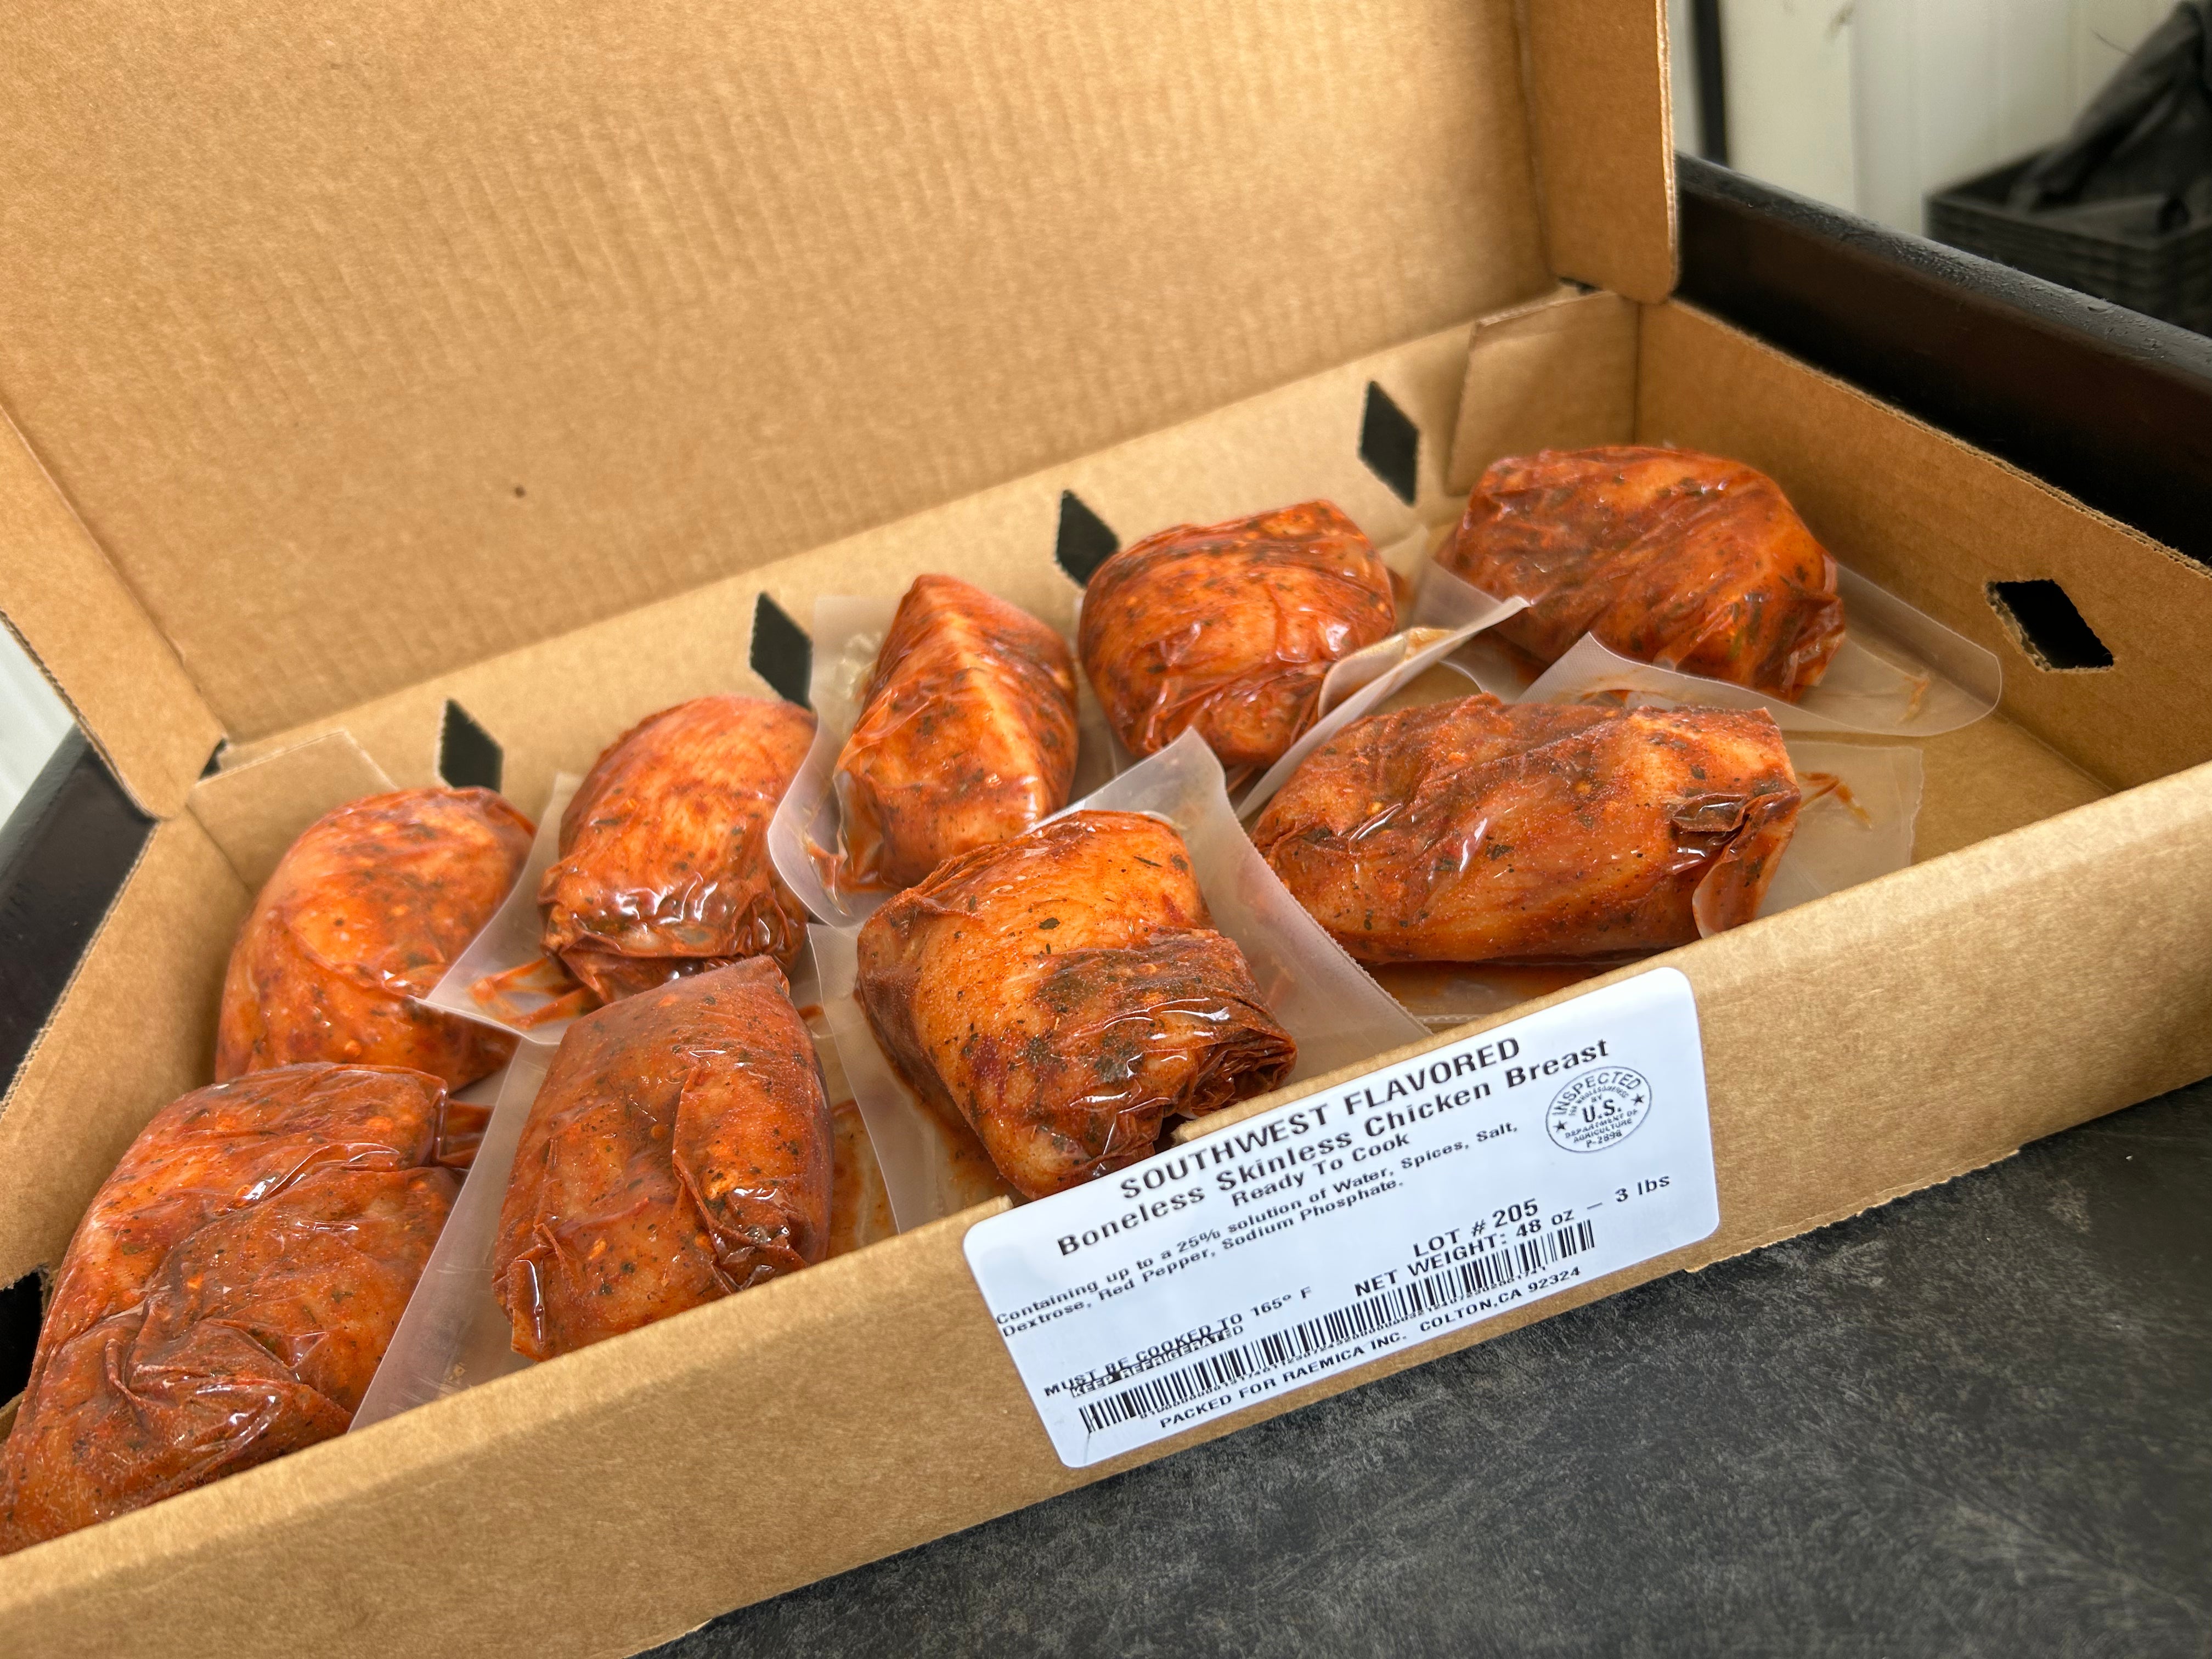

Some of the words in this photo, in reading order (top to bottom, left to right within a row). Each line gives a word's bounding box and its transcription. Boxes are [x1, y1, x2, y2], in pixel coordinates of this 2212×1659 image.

[1120, 1103, 1328, 1198] SOUTHWEST
[1344, 1037, 1520, 1115] FLAVORED
[1551, 1071, 1641, 1115] INSPECTED
[1565, 1113, 1624, 1138] DEPARTMENT
[1573, 1118, 1633, 1143] AGRICULTURE
[1582, 1098, 1622, 1123] U.S.
[1057, 1186, 1205, 1256] Boneless
[1215, 1131, 1352, 1190] Skinless
[1363, 1081, 1491, 1138] Chicken
[1505, 1039, 1609, 1088] Breast
[1231, 1171, 1305, 1207] Ready
[1313, 1156, 1344, 1177] To
[1352, 1133, 1410, 1163] Cook
[996, 1280, 1098, 1325] Containing
[1106, 1267, 1130, 1283] up
[1136, 1257, 1154, 1270] to
[1161, 1249, 1172, 1260] a
[1177, 1228, 1221, 1252] 25%
[1228, 1199, 1302, 1233] solution
[1308, 1189, 1327, 1203] of
[1332, 1167, 1394, 1193] Water,
[1401, 1141, 1469, 1170] Spices,
[1476, 1121, 1517, 1142] Salt,
[1002, 1300, 1092, 1338] Dextrose,
[1098, 1278, 1136, 1301] Red
[1142, 1248, 1216, 1283] Pepper,
[1222, 1216, 1294, 1250] Sodium
[1300, 1179, 1404, 1222] Phosphate.
[1354, 1269, 1398, 1297] NET
[1407, 1232, 1506, 1277] WEIGHT:
[1516, 1218, 1541, 1237] 48
[1551, 1209, 1574, 1225] oz
[1615, 1188, 1628, 1202] 3
[1637, 1176, 1671, 1195] lbs
[1413, 1228, 1460, 1257] LOT
[1471, 1219, 1486, 1237] #
[1492, 1197, 1538, 1228] 205
[1044, 1369, 1097, 1397] MUST
[1104, 1356, 1130, 1372] BE
[1136, 1324, 1211, 1363] COOKED
[1217, 1313, 1243, 1331] TO
[1301, 1286, 1312, 1299] F
[1070, 1374, 1114, 1397] KEEP
[1120, 1324, 1244, 1379] REFRIGERATED
[1160, 1393, 1232, 1427] PACKED
[1239, 1378, 1277, 1400] FOR
[1283, 1345, 1365, 1383] RAEMICA
[1371, 1330, 1407, 1351] INC.
[1419, 1288, 1522, 1332] COLTON,CA
[1527, 1266, 1581, 1293] 92324
